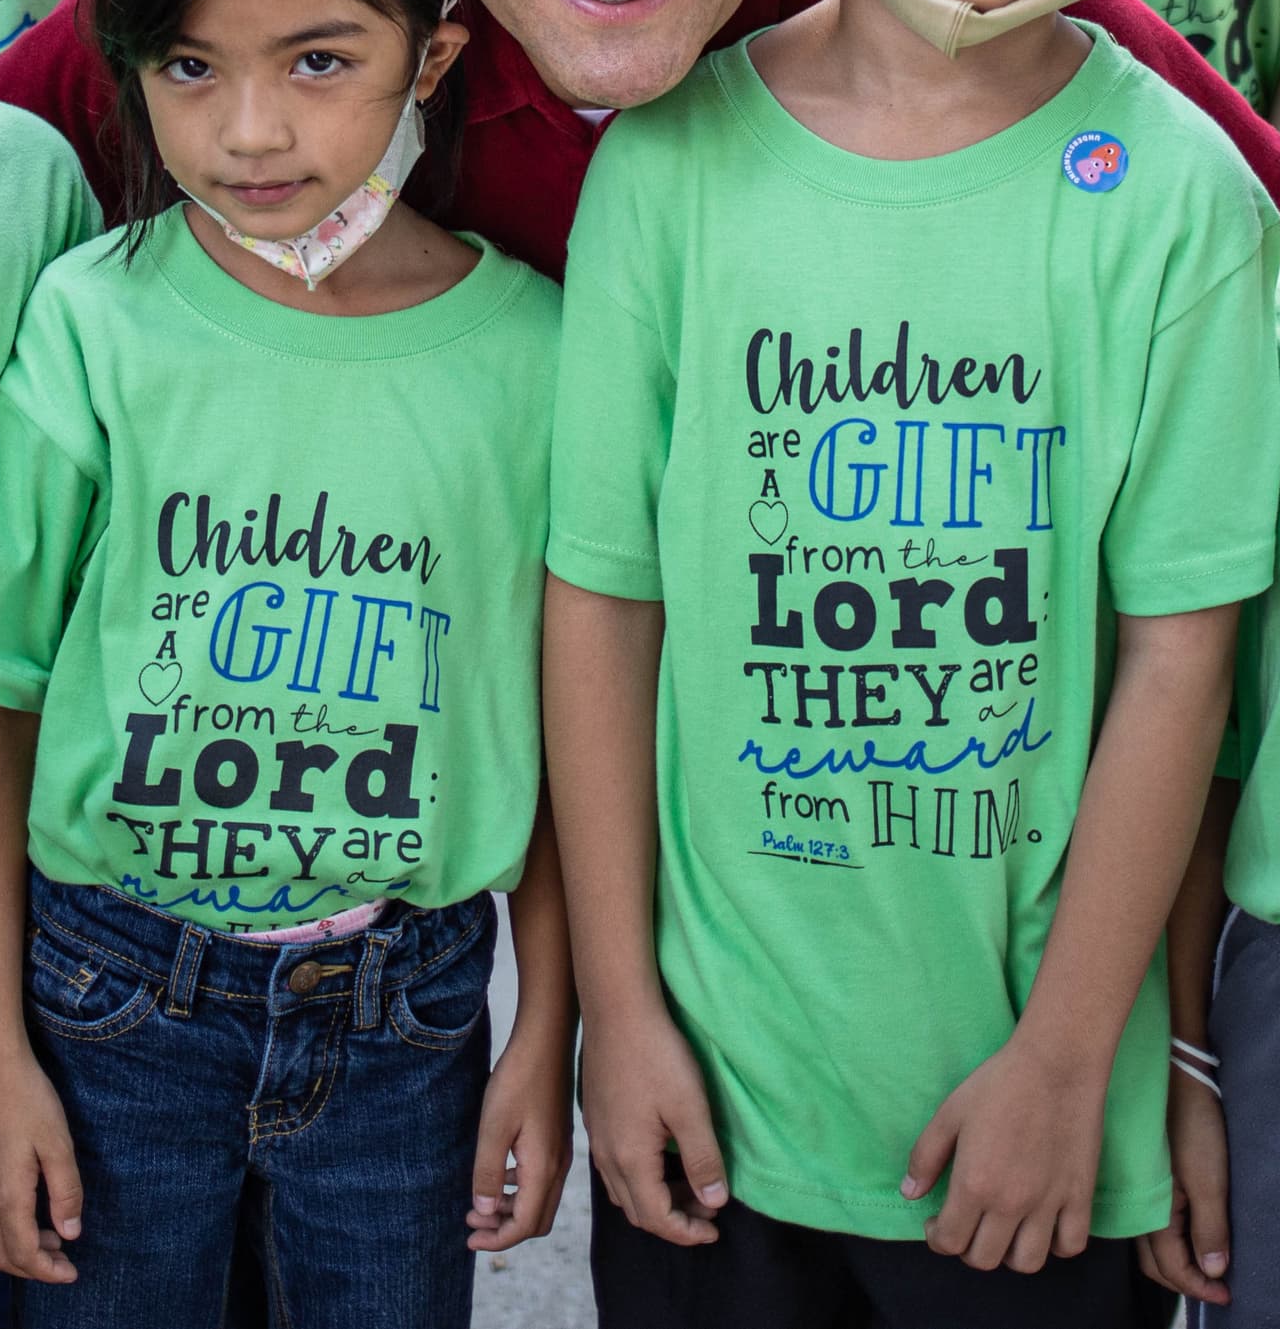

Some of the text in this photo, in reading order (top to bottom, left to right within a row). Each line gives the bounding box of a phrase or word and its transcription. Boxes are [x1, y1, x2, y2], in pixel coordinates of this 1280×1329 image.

[746, 320, 1041, 414] Children
[748, 417, 1066, 531] are A GIFT
[157, 491, 441, 584] Children
[785, 535, 987, 574] from the
[749, 547, 1050, 652] Lord:
[151, 581, 450, 713] are A GIFT
[171, 694, 379, 736] from the
[743, 652, 1038, 728] THEY are a
[112, 713, 438, 819] Lord:
[737, 697, 1052, 779] reward
[762, 781, 850, 823] from
[106, 812, 423, 884] THEY are a
[762, 830, 850, 860] Psalm 127:3
